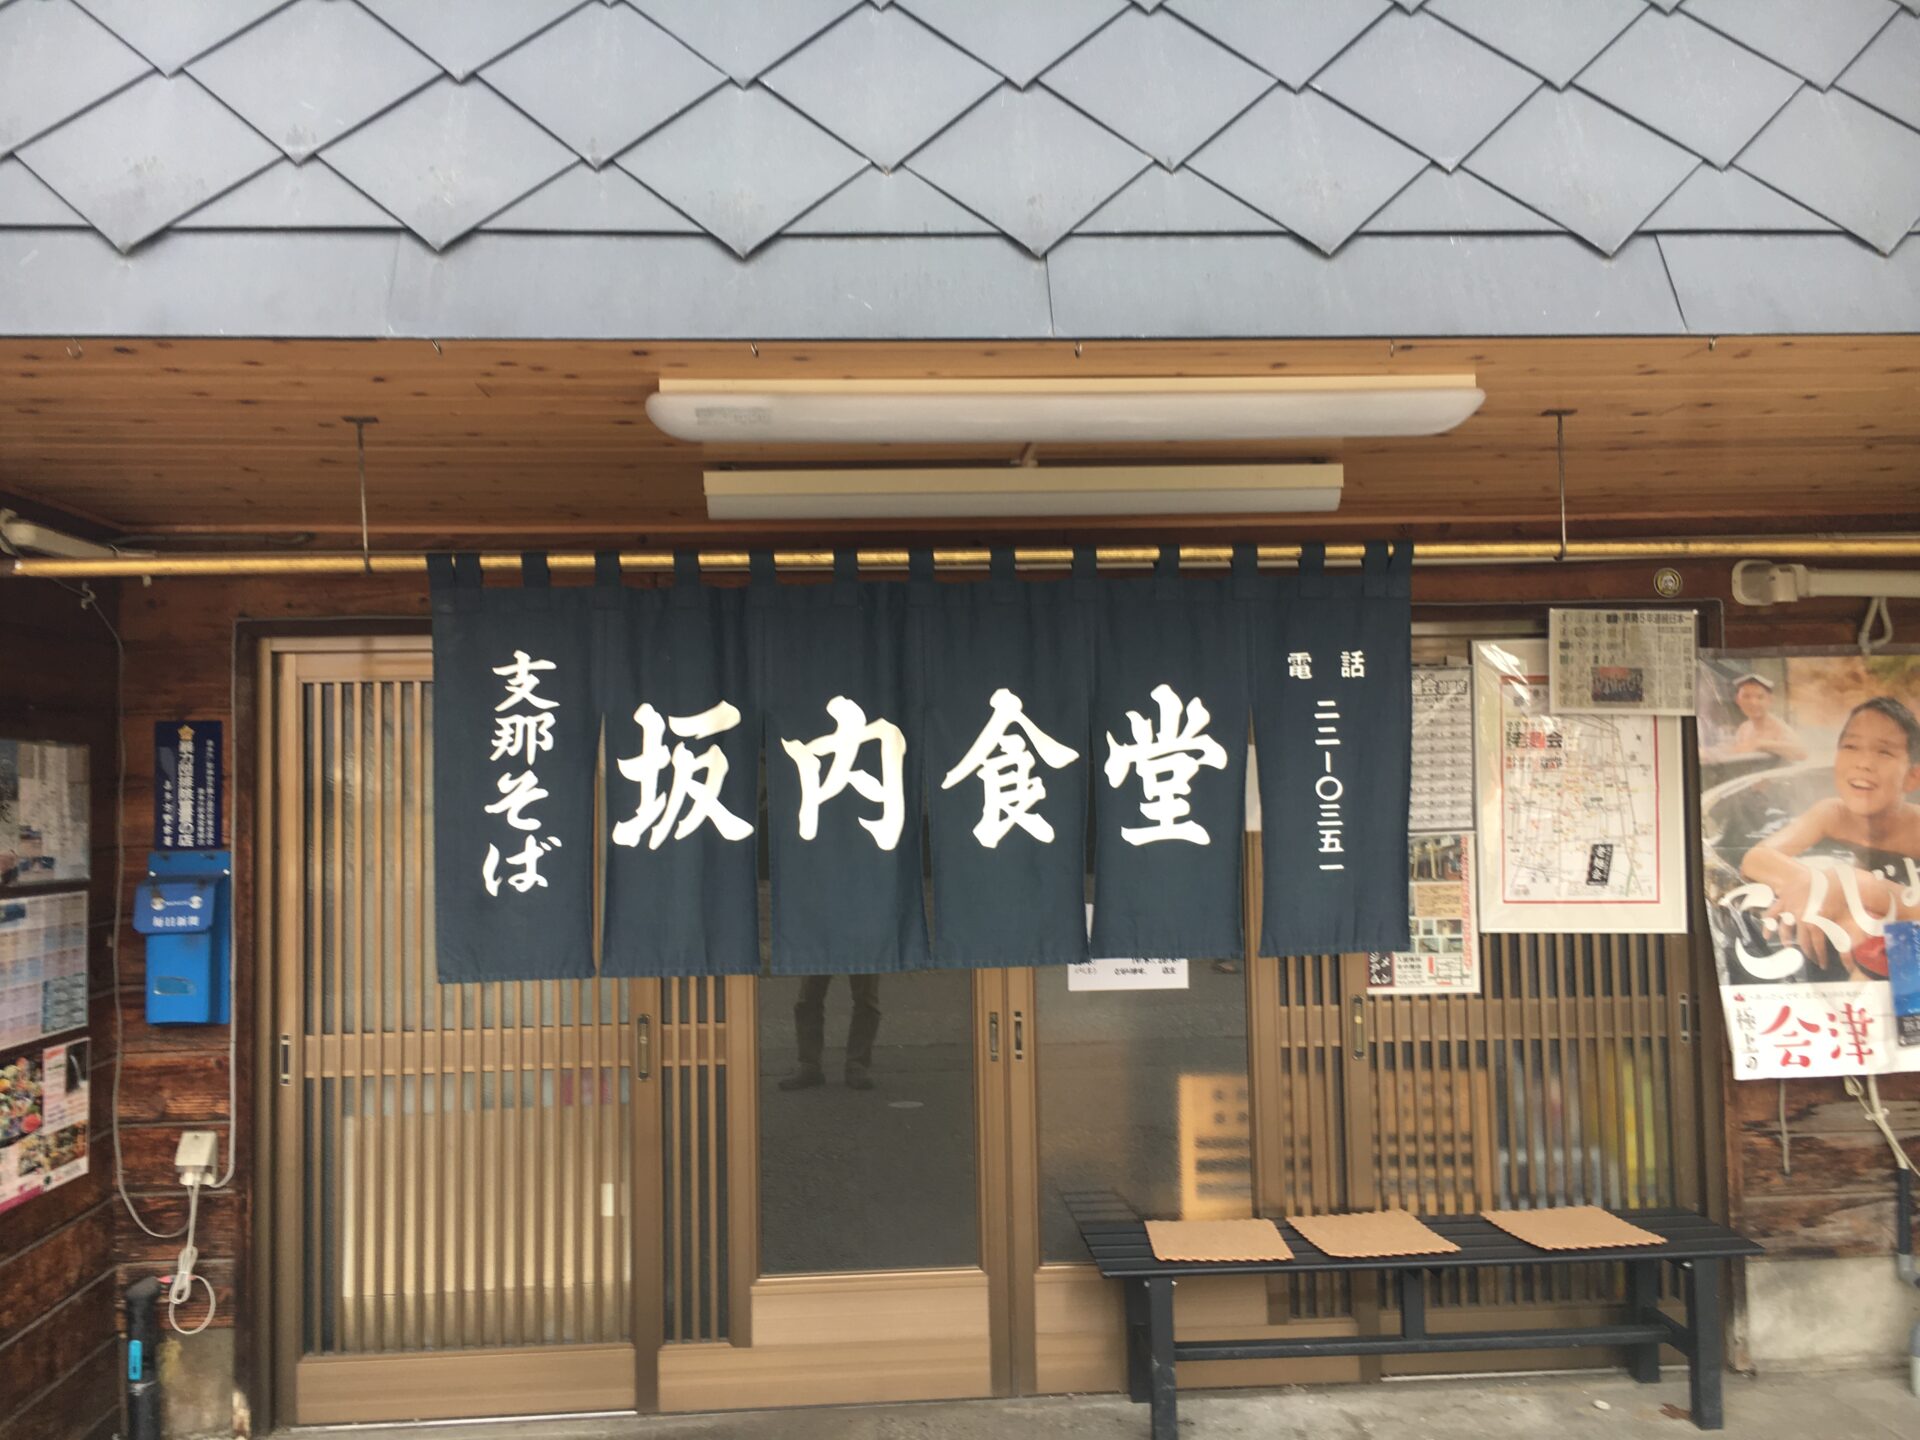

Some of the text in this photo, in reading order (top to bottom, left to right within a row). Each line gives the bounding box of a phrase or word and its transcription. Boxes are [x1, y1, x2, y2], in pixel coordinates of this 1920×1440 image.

[1287, 651, 1365, 679] 電話
[483, 650, 561, 897] 支那そば
[612, 684, 1228, 850] 坂内食堂
[152, 915, 199, 928] 毎日新聞
[1760, 1003, 1874, 1066] 会津
